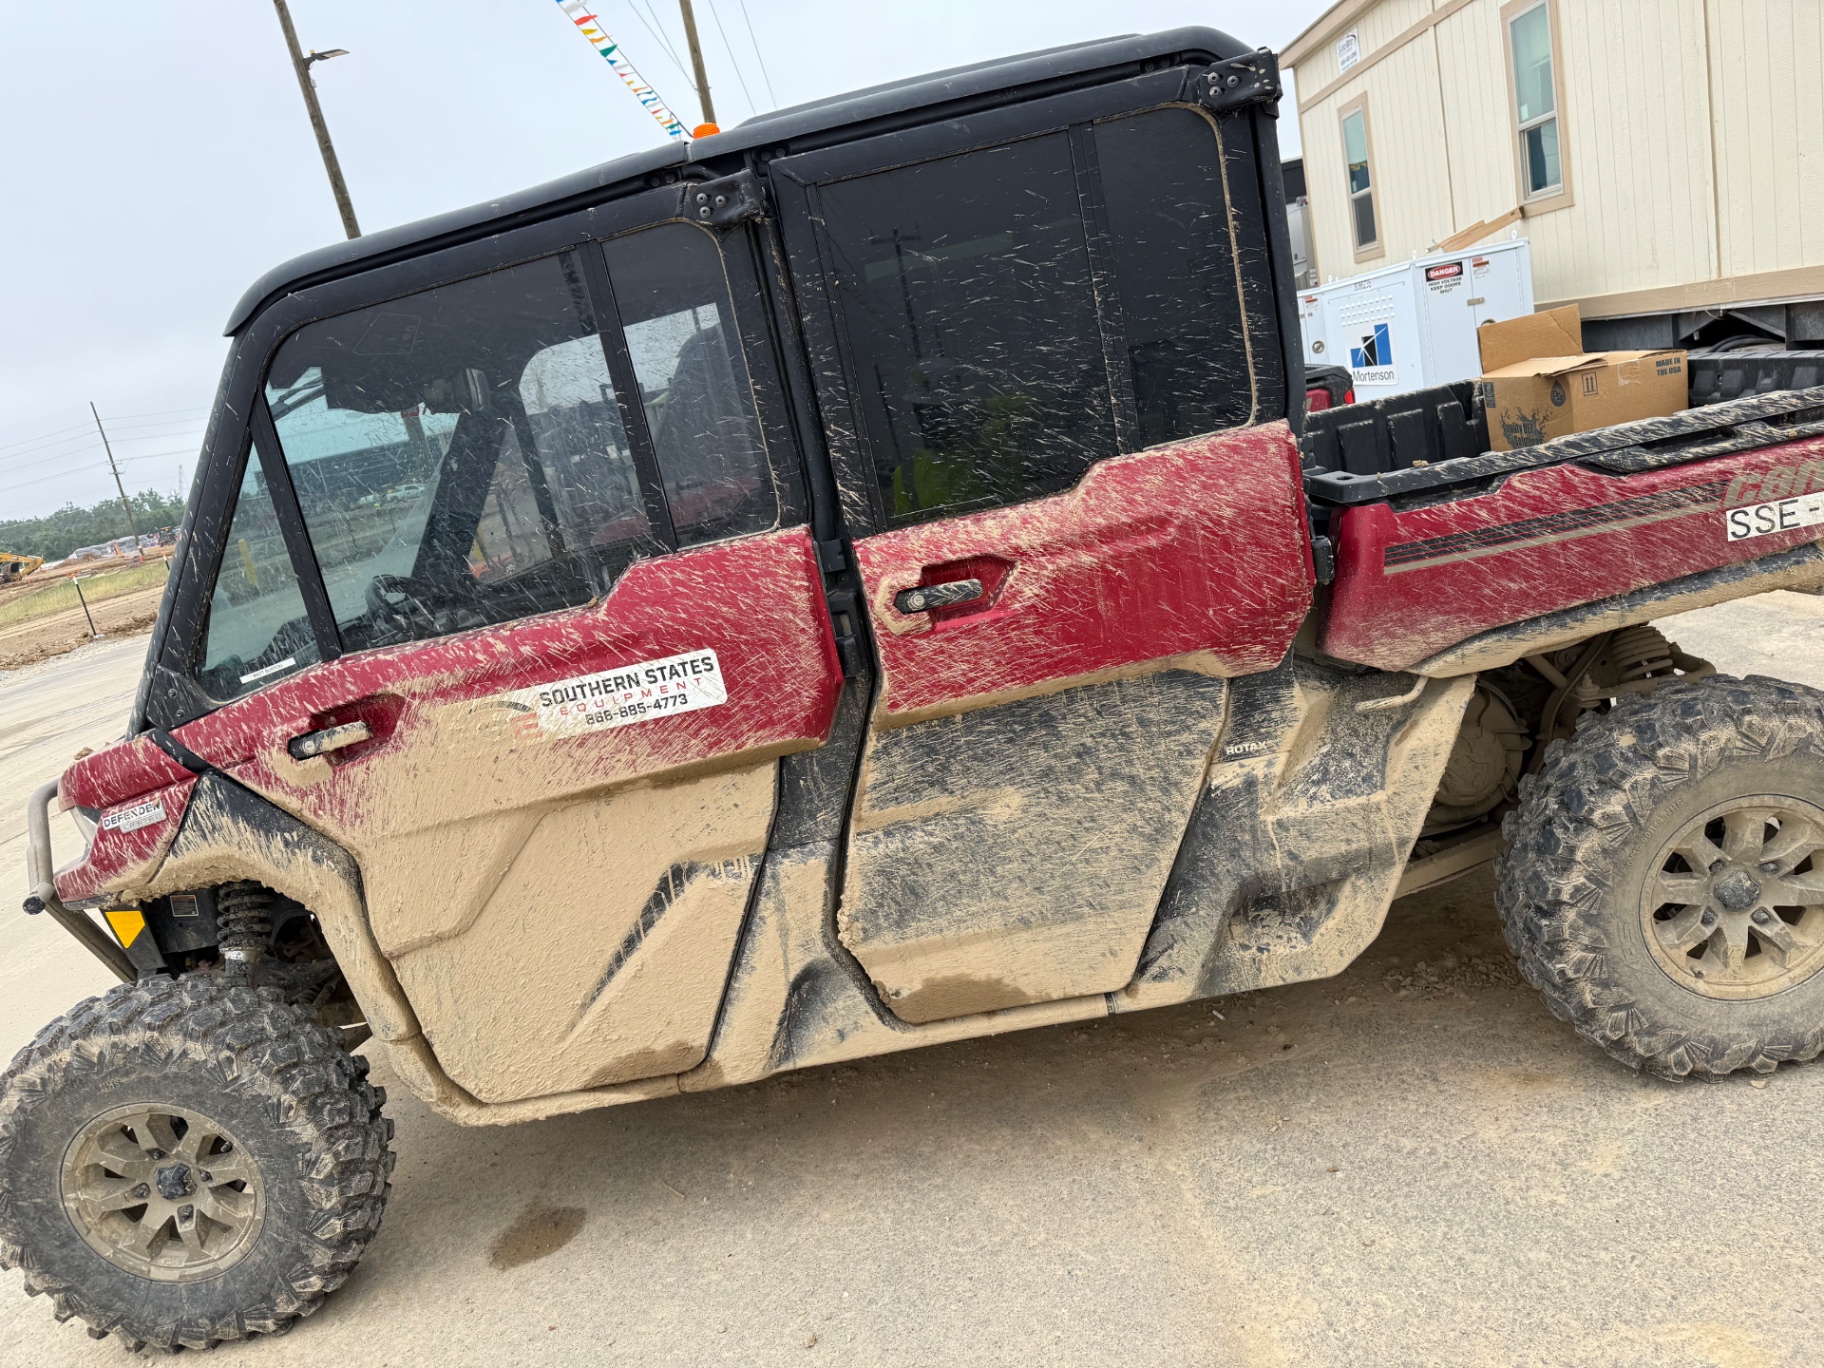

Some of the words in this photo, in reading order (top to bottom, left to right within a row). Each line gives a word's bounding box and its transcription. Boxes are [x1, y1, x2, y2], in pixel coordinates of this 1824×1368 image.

[1431, 265, 1459, 277] DANGER
[1656, 358, 1673, 367] MADE
[1353, 370, 1395, 382] Mortenson
[1657, 368, 1668, 376] THE
[1669, 366, 1681, 374] USA
[539, 671, 641, 707] SOUTHERN
[644, 656, 715, 684] STATES
[560, 677, 702, 716] EQUIPMENT
[1226, 741, 1268, 755] ROTAX
